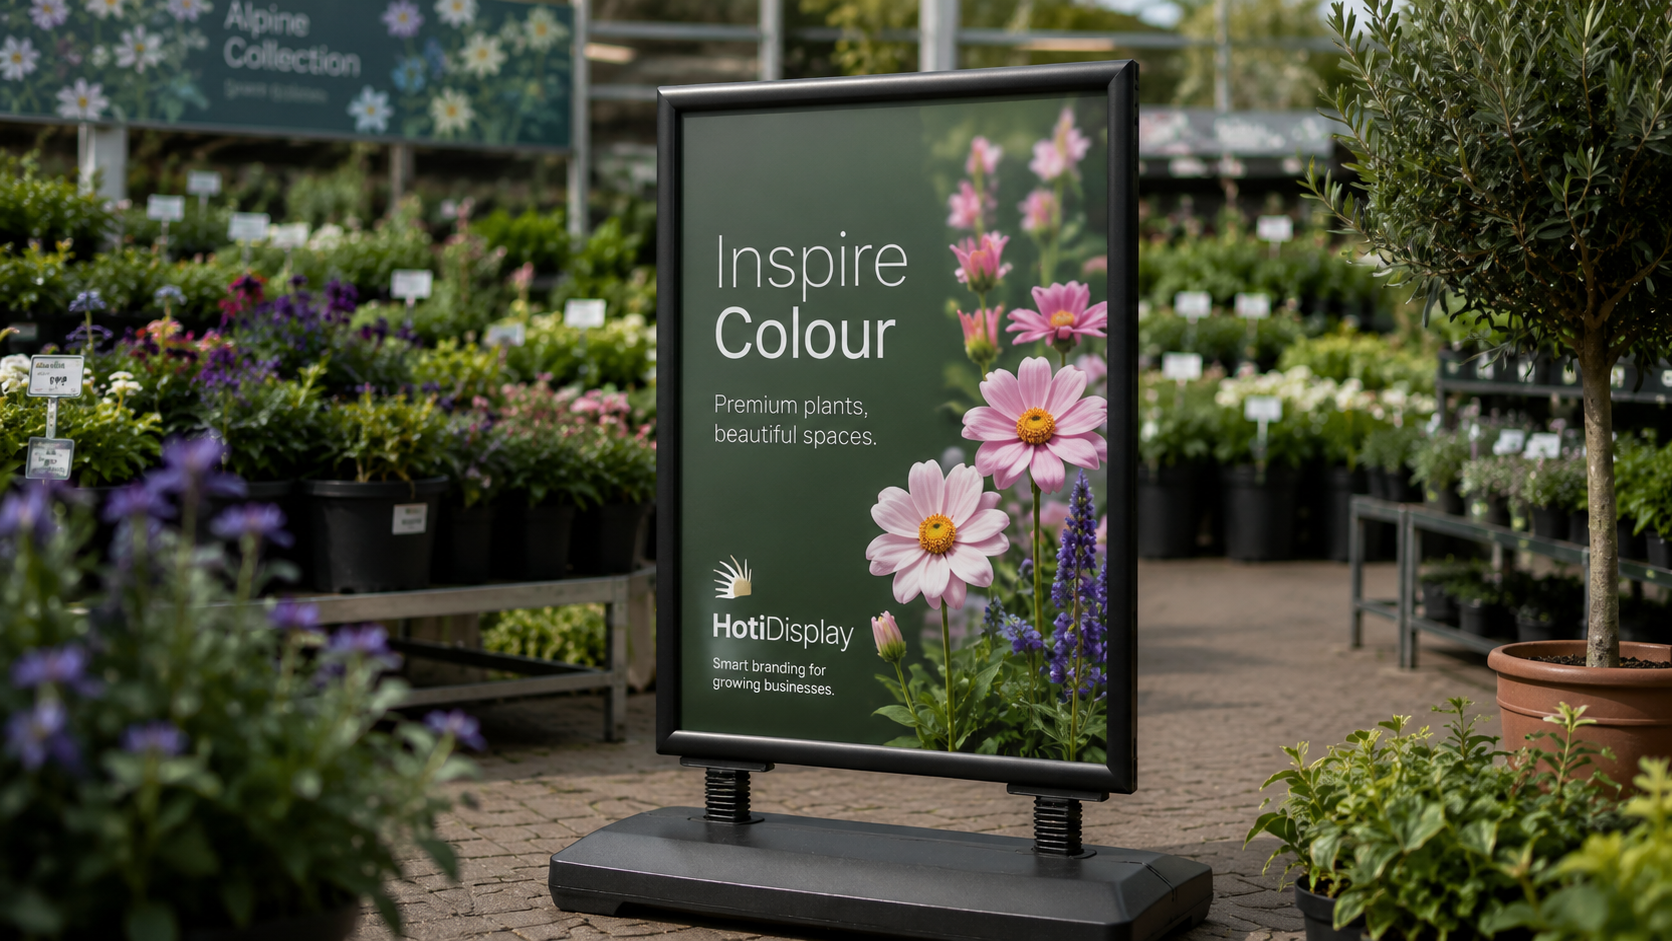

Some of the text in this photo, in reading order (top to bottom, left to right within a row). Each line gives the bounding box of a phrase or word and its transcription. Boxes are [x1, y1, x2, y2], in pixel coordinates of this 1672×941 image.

[223, 0, 311, 38] Alpine
[223, 35, 362, 78] Collection
[718, 230, 908, 303] Inspire
[715, 306, 896, 360] Colour
[714, 394, 868, 419] Premium plants,
[714, 424, 877, 449] beautiful spaces.
[713, 613, 854, 652] HotiDisplay
[713, 657, 827, 678] Smart branding for
[713, 677, 835, 696] growing businesses.
